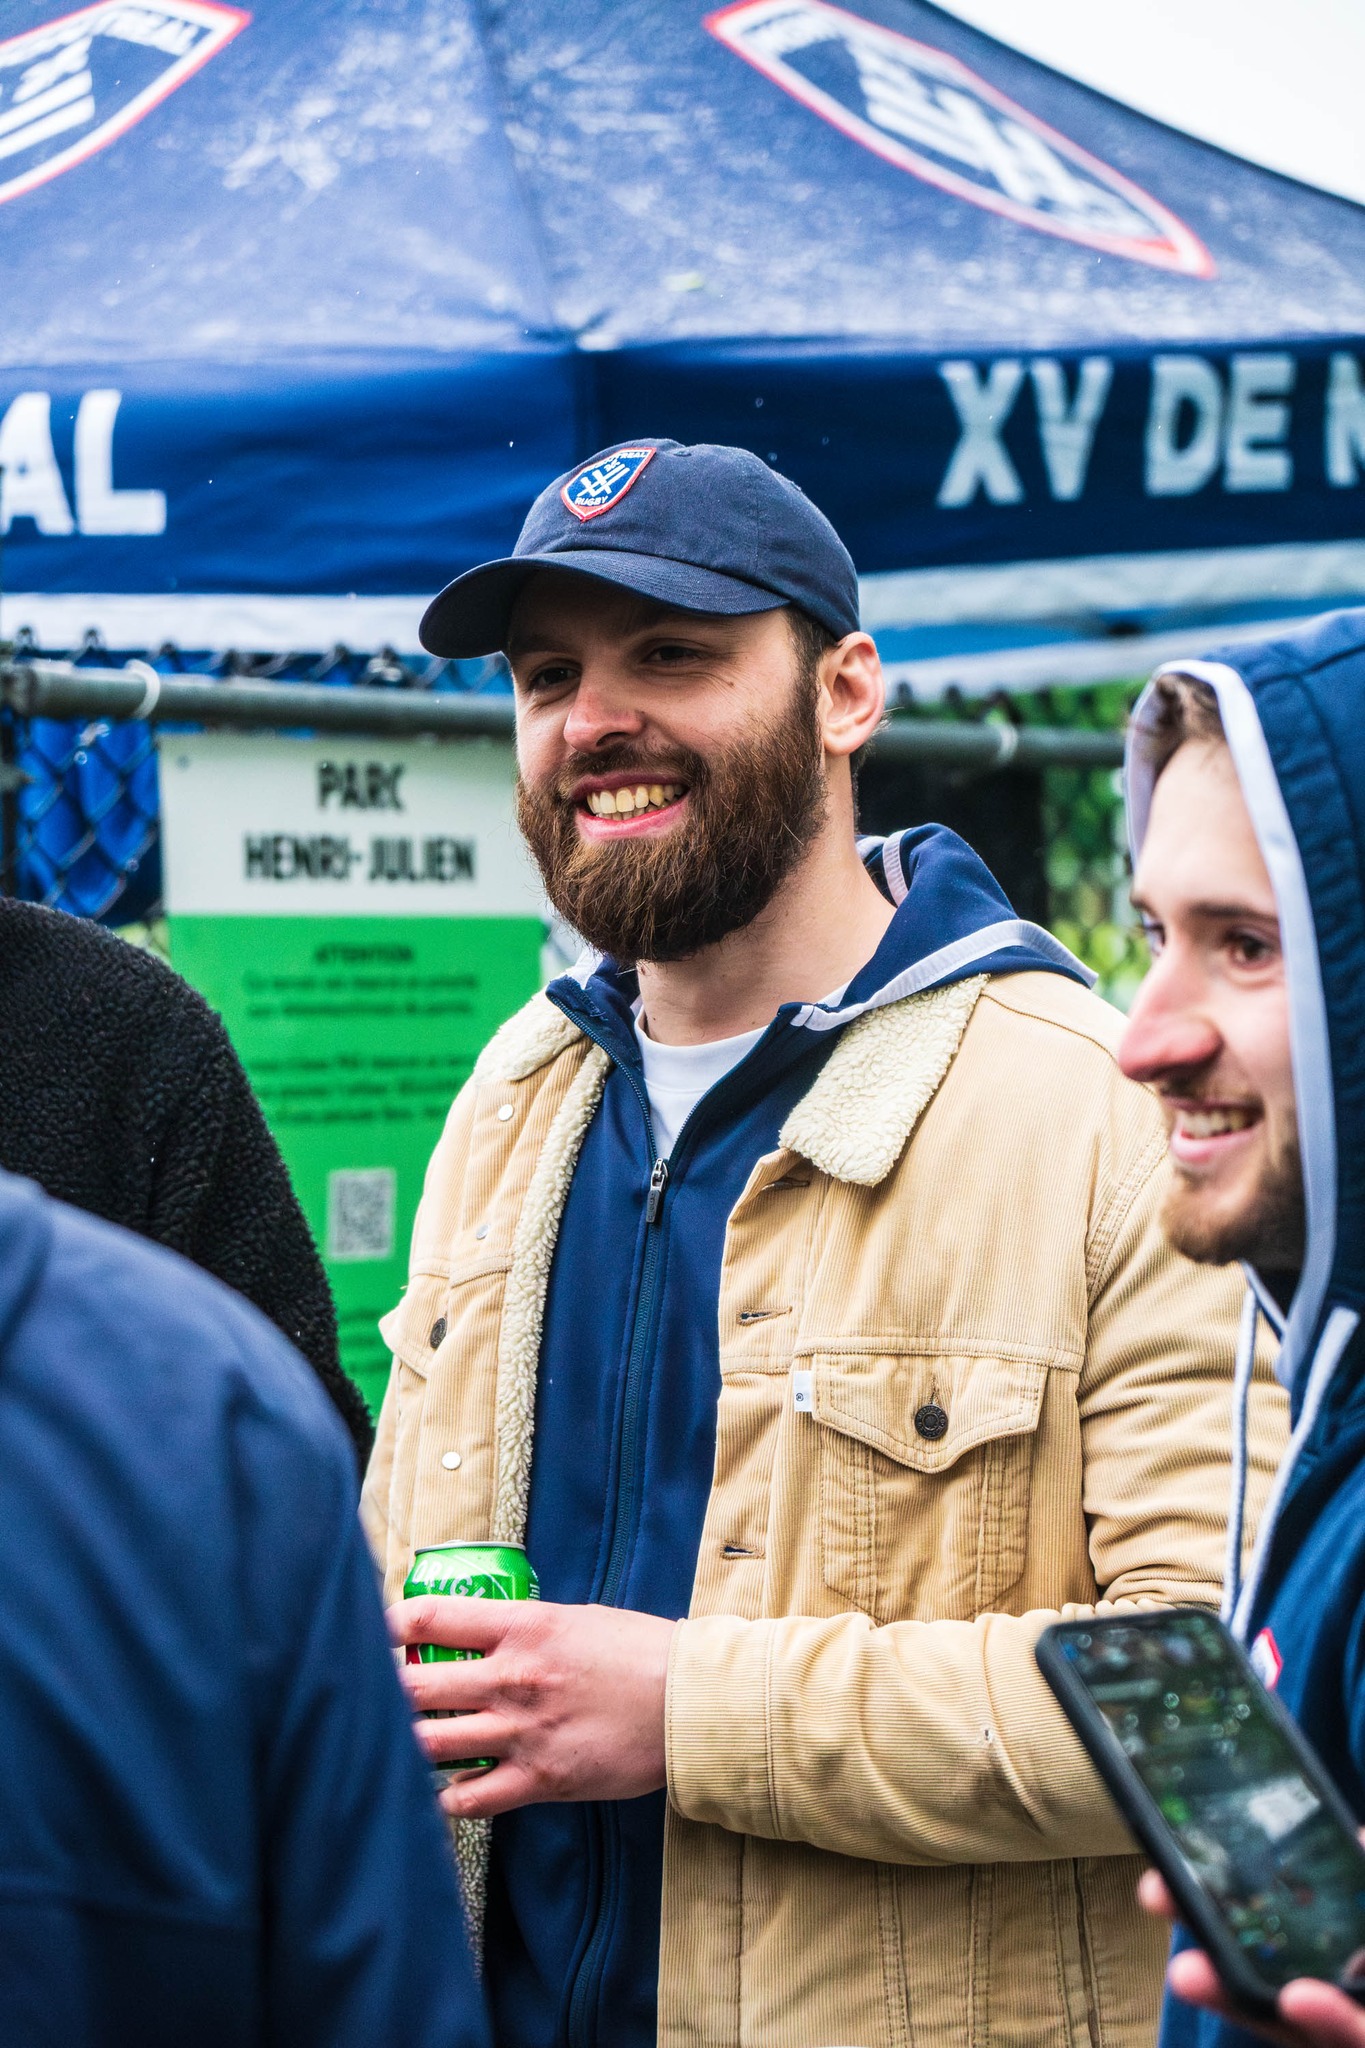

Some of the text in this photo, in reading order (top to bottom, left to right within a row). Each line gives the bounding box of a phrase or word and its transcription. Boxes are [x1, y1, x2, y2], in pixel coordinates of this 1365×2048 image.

[938, 358, 1112, 508] XV
[1144, 353, 1295, 496] DE
[574, 495, 609, 506] RUGBY
[317, 760, 405, 810] PARC
[244, 833, 475, 881] HENRI-JULIEN
